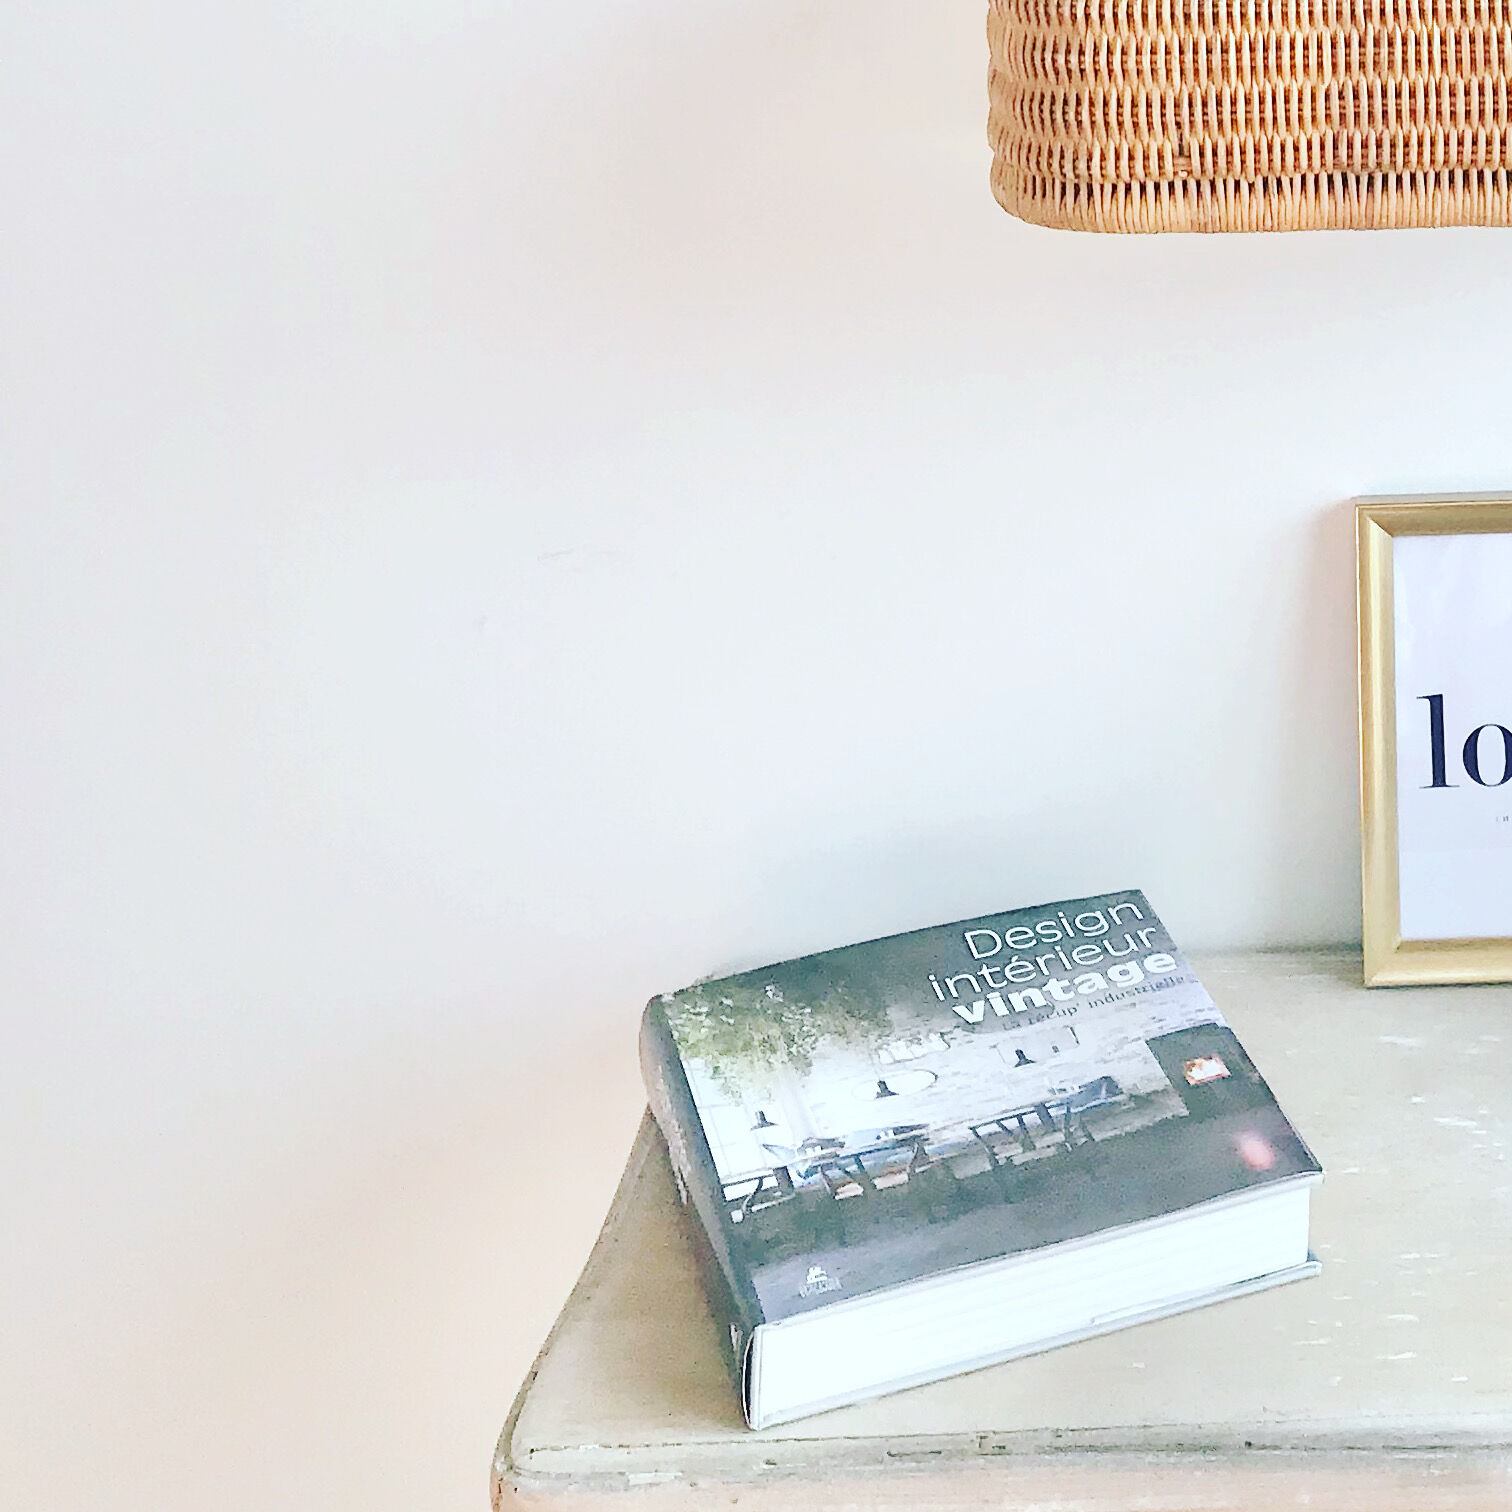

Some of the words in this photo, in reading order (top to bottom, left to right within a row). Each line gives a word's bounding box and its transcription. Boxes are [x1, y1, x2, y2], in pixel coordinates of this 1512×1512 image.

[928, 925, 1157, 1002] intérieur
[964, 901, 1145, 960] Design
[951, 952, 1179, 1025] vintage
